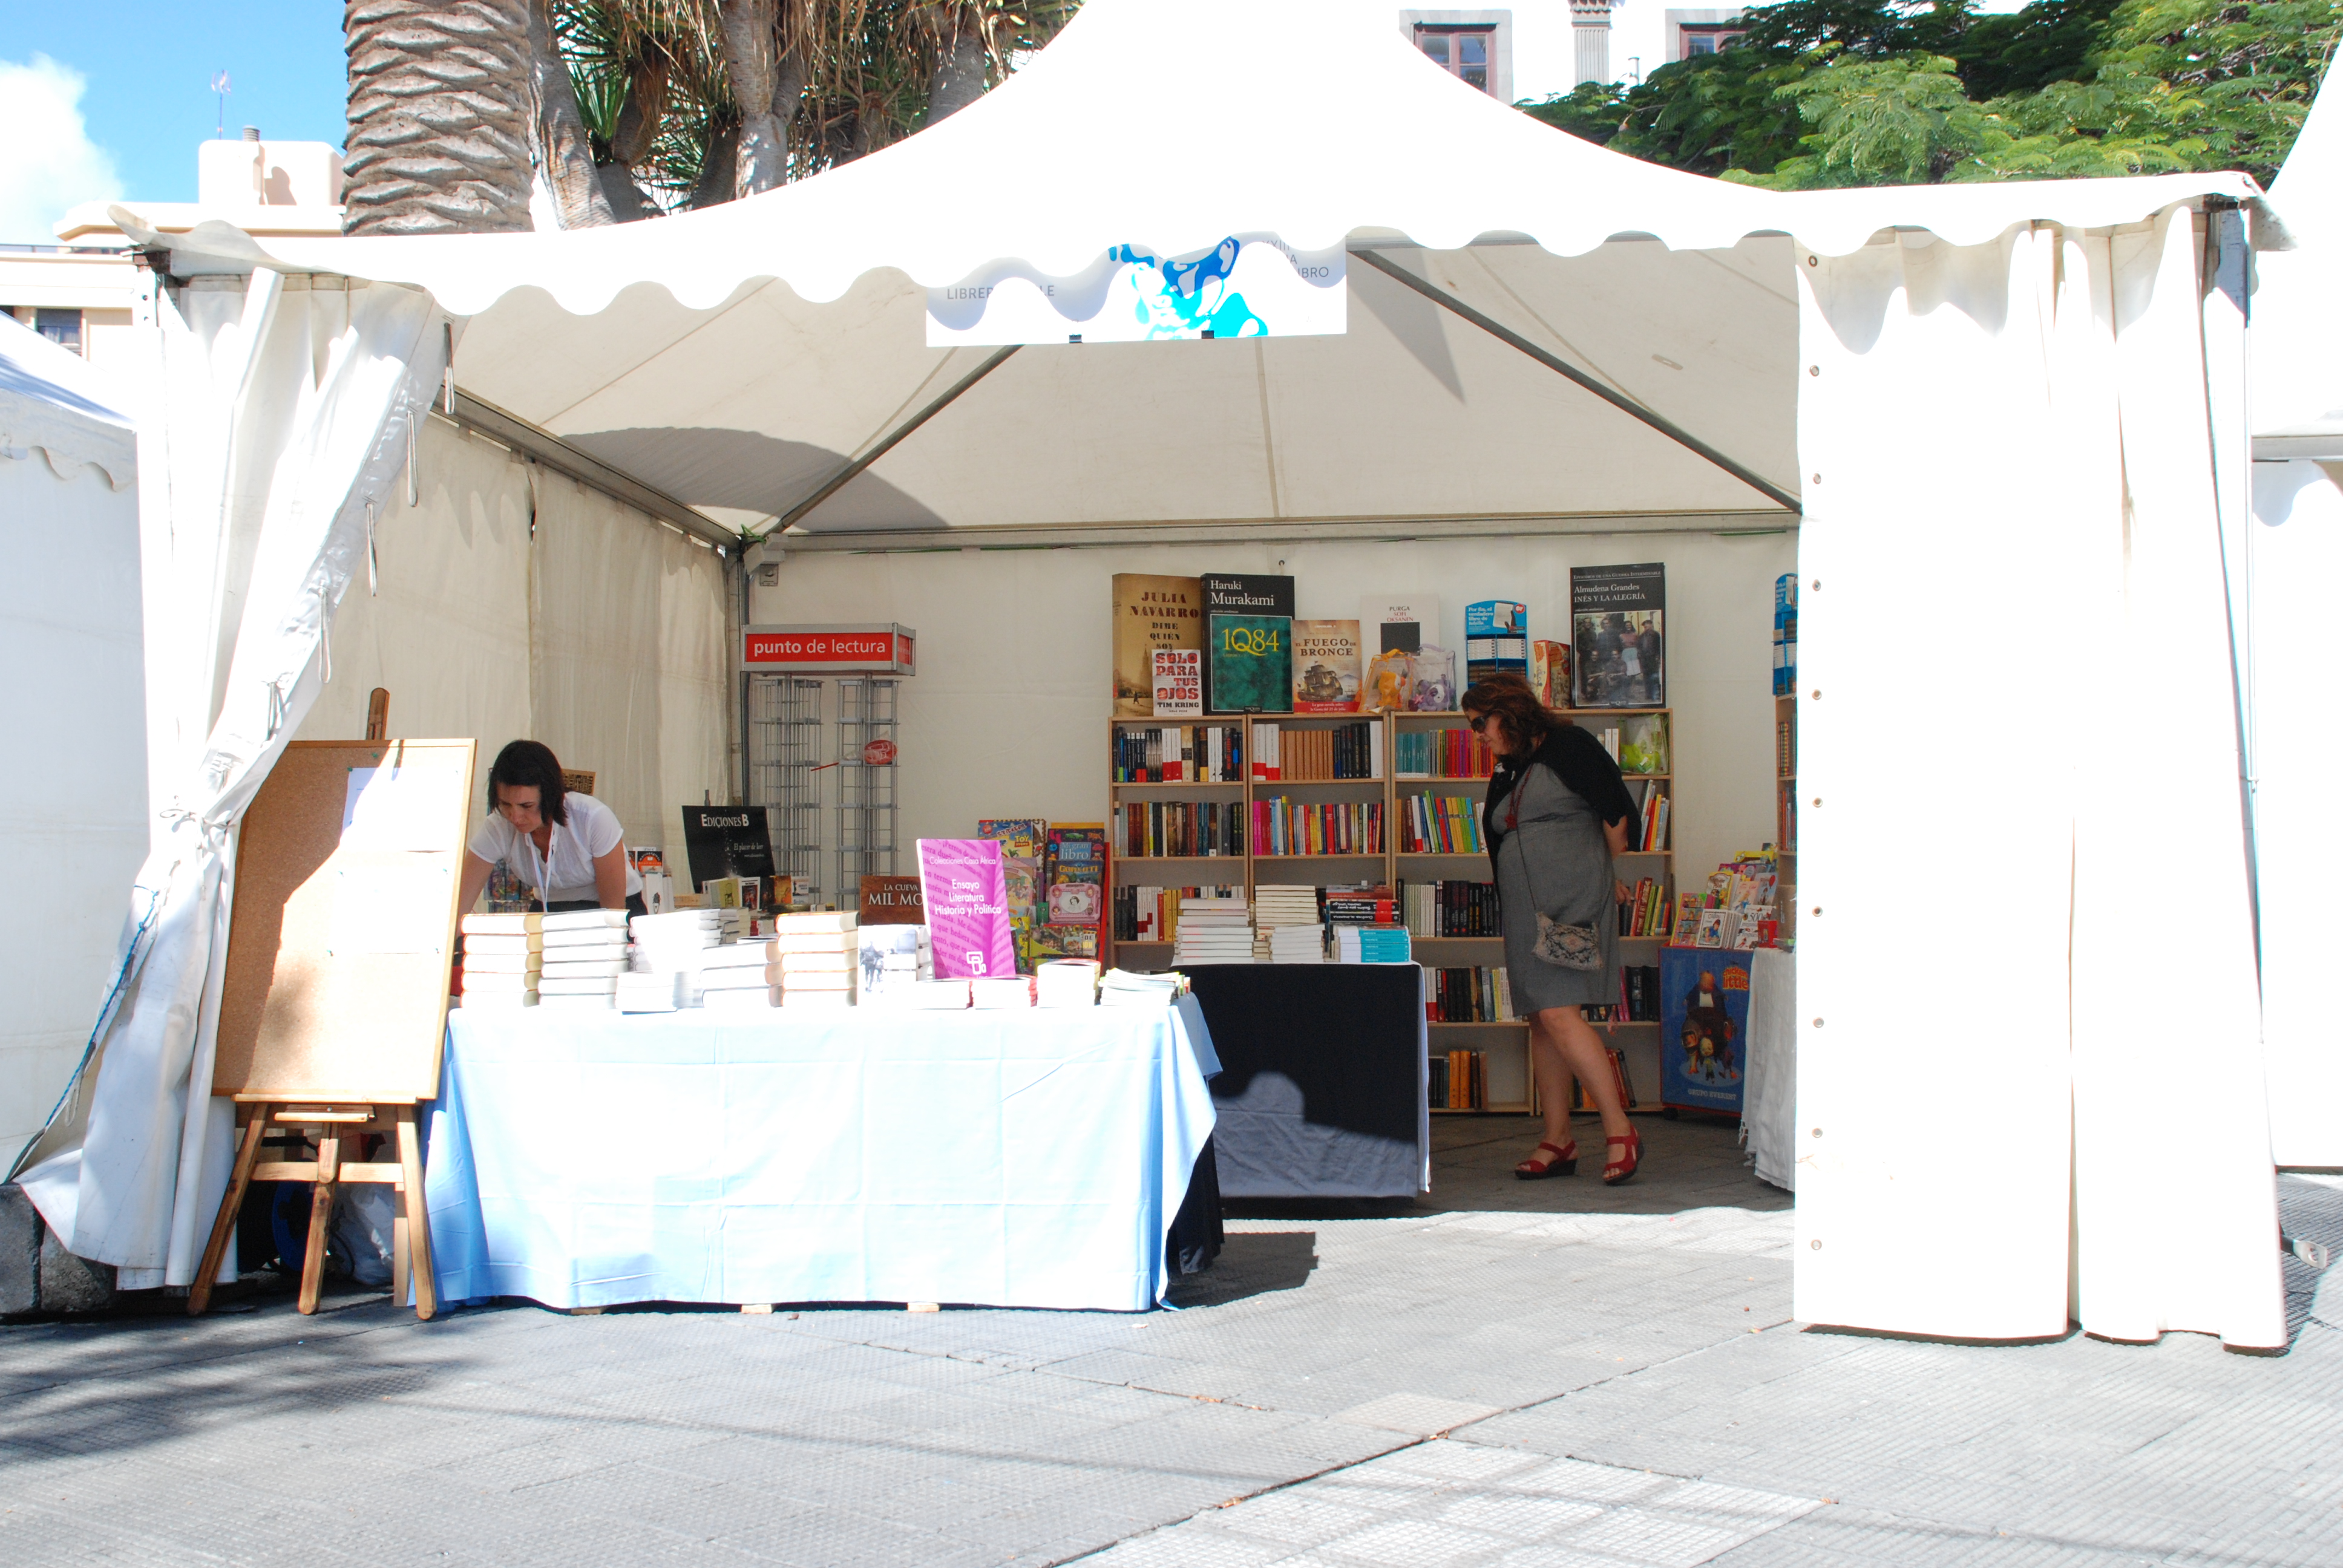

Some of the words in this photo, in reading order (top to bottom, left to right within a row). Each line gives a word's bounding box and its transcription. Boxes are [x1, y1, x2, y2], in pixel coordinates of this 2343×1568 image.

[1210, 580, 1242, 590] Haruki
[1574, 585, 1609, 593] Almudena
[1141, 592, 1187, 604] JULIA
[1211, 592, 1274, 606] Murakami
[1574, 594, 1591, 603] INÉS
[1612, 592, 1646, 601] ALEGRÍA
[1130, 606, 1199, 618] NAVARRO
[1150, 632, 1181, 641] QUIÉN
[1221, 627, 1279, 656] 1Q84
[1303, 638, 1349, 647] FUEGO
[754, 641, 802, 656] punto
[807, 639, 826, 653] de
[832, 639, 885, 653] lectura
[1300, 648, 1353, 656] BRONCE
[1156, 665, 1198, 676] PARA
[1173, 678, 1199, 687] TUS
[1156, 687, 1199, 700] OJOS
[701, 814, 742, 827] EDICIONES
[741, 814, 749, 826] B
[980, 855, 996, 864] África
[1061, 849, 1089, 859] libro
[952, 879, 980, 892] Ensayo
[868, 893, 895, 906] MIL
[899, 893, 923, 906] MO
[949, 892, 985, 902] Literatura
[934, 905, 965, 915] Historia
[967, 907, 972, 917] y
[974, 903, 1001, 914] Política
[1722, 976, 1749, 990] little
[1688, 1088, 1708, 1097] GRUPO
[1709, 1091, 1737, 1100] EVEREST
